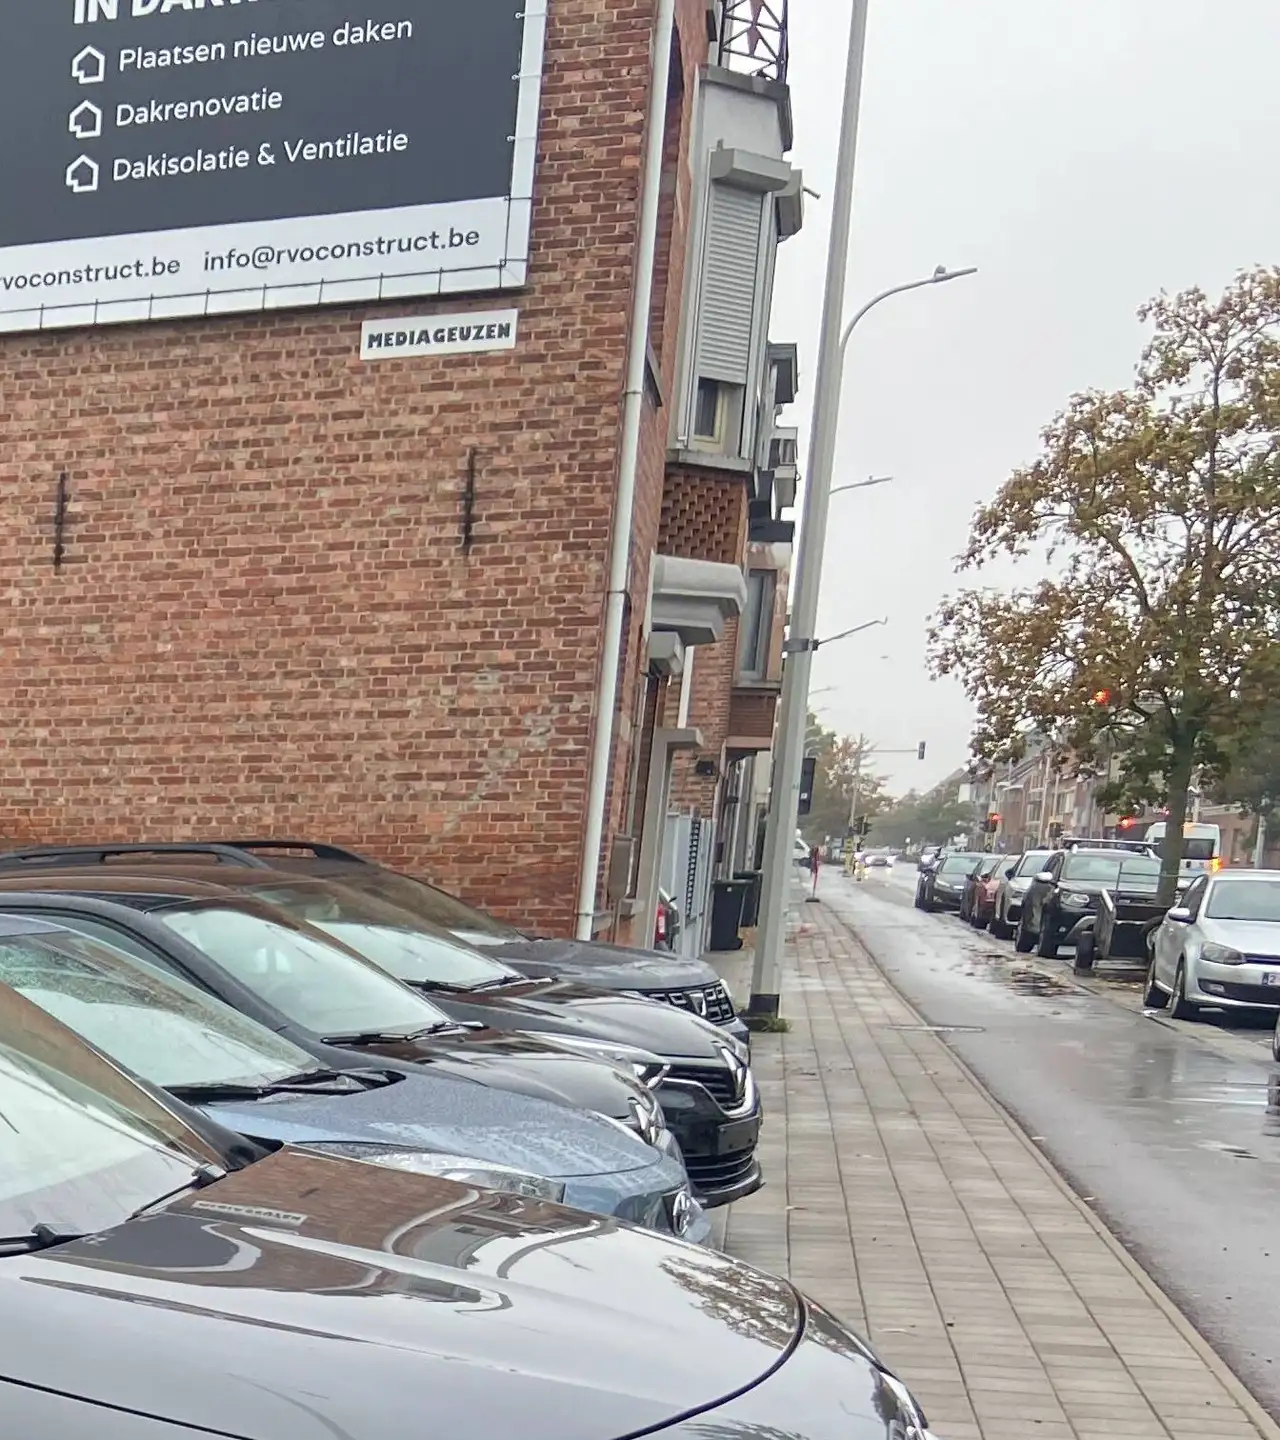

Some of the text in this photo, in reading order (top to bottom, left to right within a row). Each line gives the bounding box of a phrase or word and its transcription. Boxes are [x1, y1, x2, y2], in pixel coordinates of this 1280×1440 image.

[118, 17, 414, 72] Plaatsen nieuwe daken
[115, 87, 284, 127] Dakrenovatie
[112, 128, 409, 181] Dakisolatie & Ventilatie
[203, 226, 480, 272] info@rvoconstruct.be
[366, 321, 512, 350] MEDIAGEUZEN
